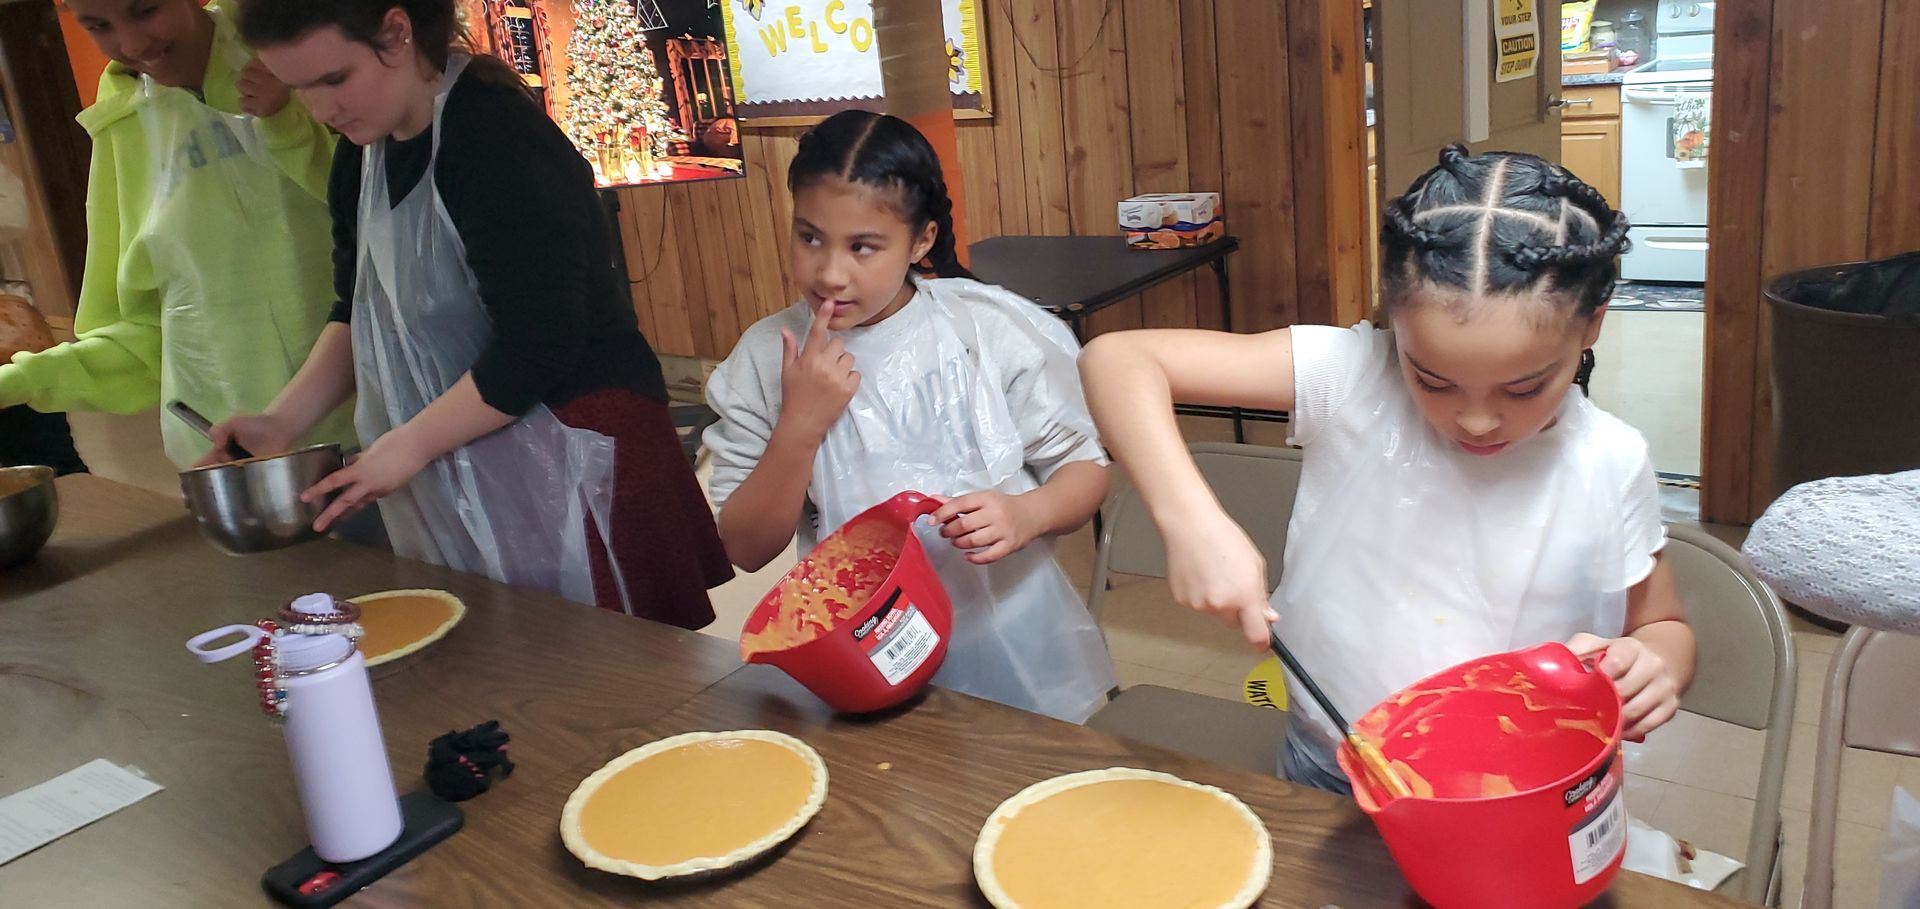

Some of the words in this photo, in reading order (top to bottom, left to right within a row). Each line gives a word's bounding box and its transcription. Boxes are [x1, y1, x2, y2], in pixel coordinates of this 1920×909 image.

[1501, 15, 1517, 26] YOUR
[1518, 11, 1531, 23] STEP
[758, 0, 873, 57] WELCO
[1502, 35, 1534, 54] CAUTION
[1500, 61, 1515, 75] STEP
